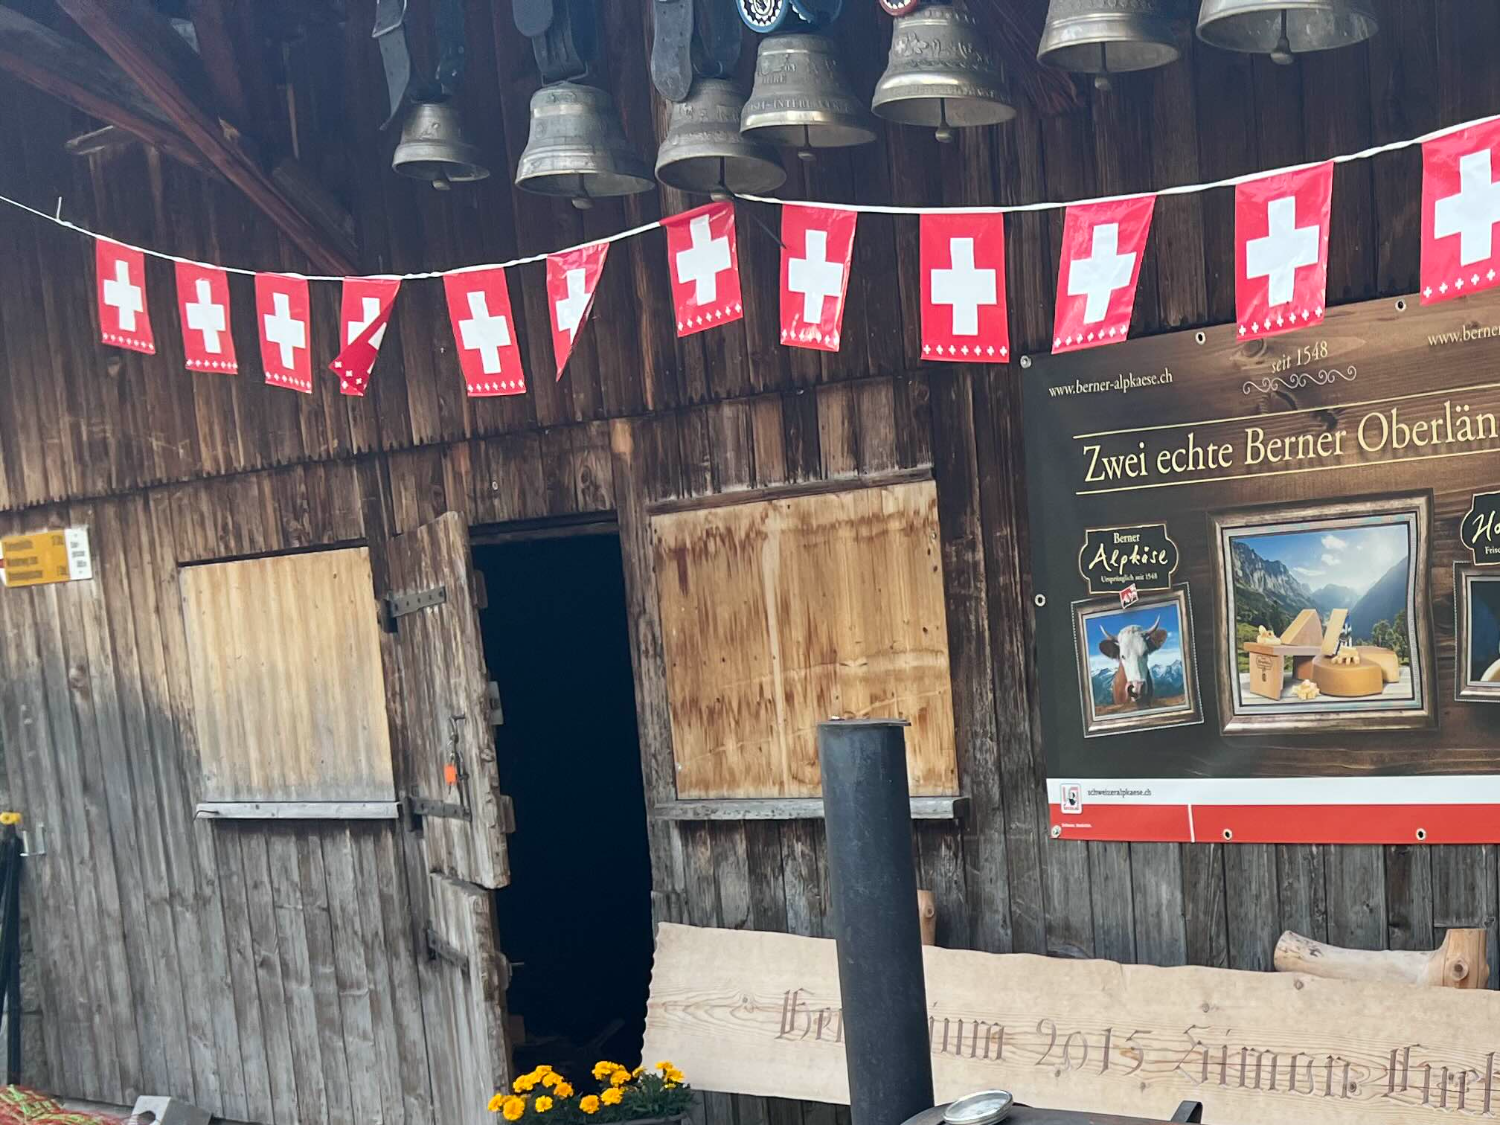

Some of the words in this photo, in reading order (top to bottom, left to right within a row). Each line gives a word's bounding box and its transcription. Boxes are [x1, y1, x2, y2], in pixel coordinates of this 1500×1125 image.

[1271, 355, 1291, 374] seit
[1296, 341, 1328, 366] 1548
[1049, 368, 1173, 397] www.berner-alpkaese.ch
[1083, 442, 1148, 482] Zwei
[1156, 432, 1233, 473] echte
[1244, 426, 1347, 466] Berner
[1113, 532, 1140, 544] Berner
[1088, 543, 1168, 575] Alpkäse
[1036, 1016, 1153, 1077] 2015
